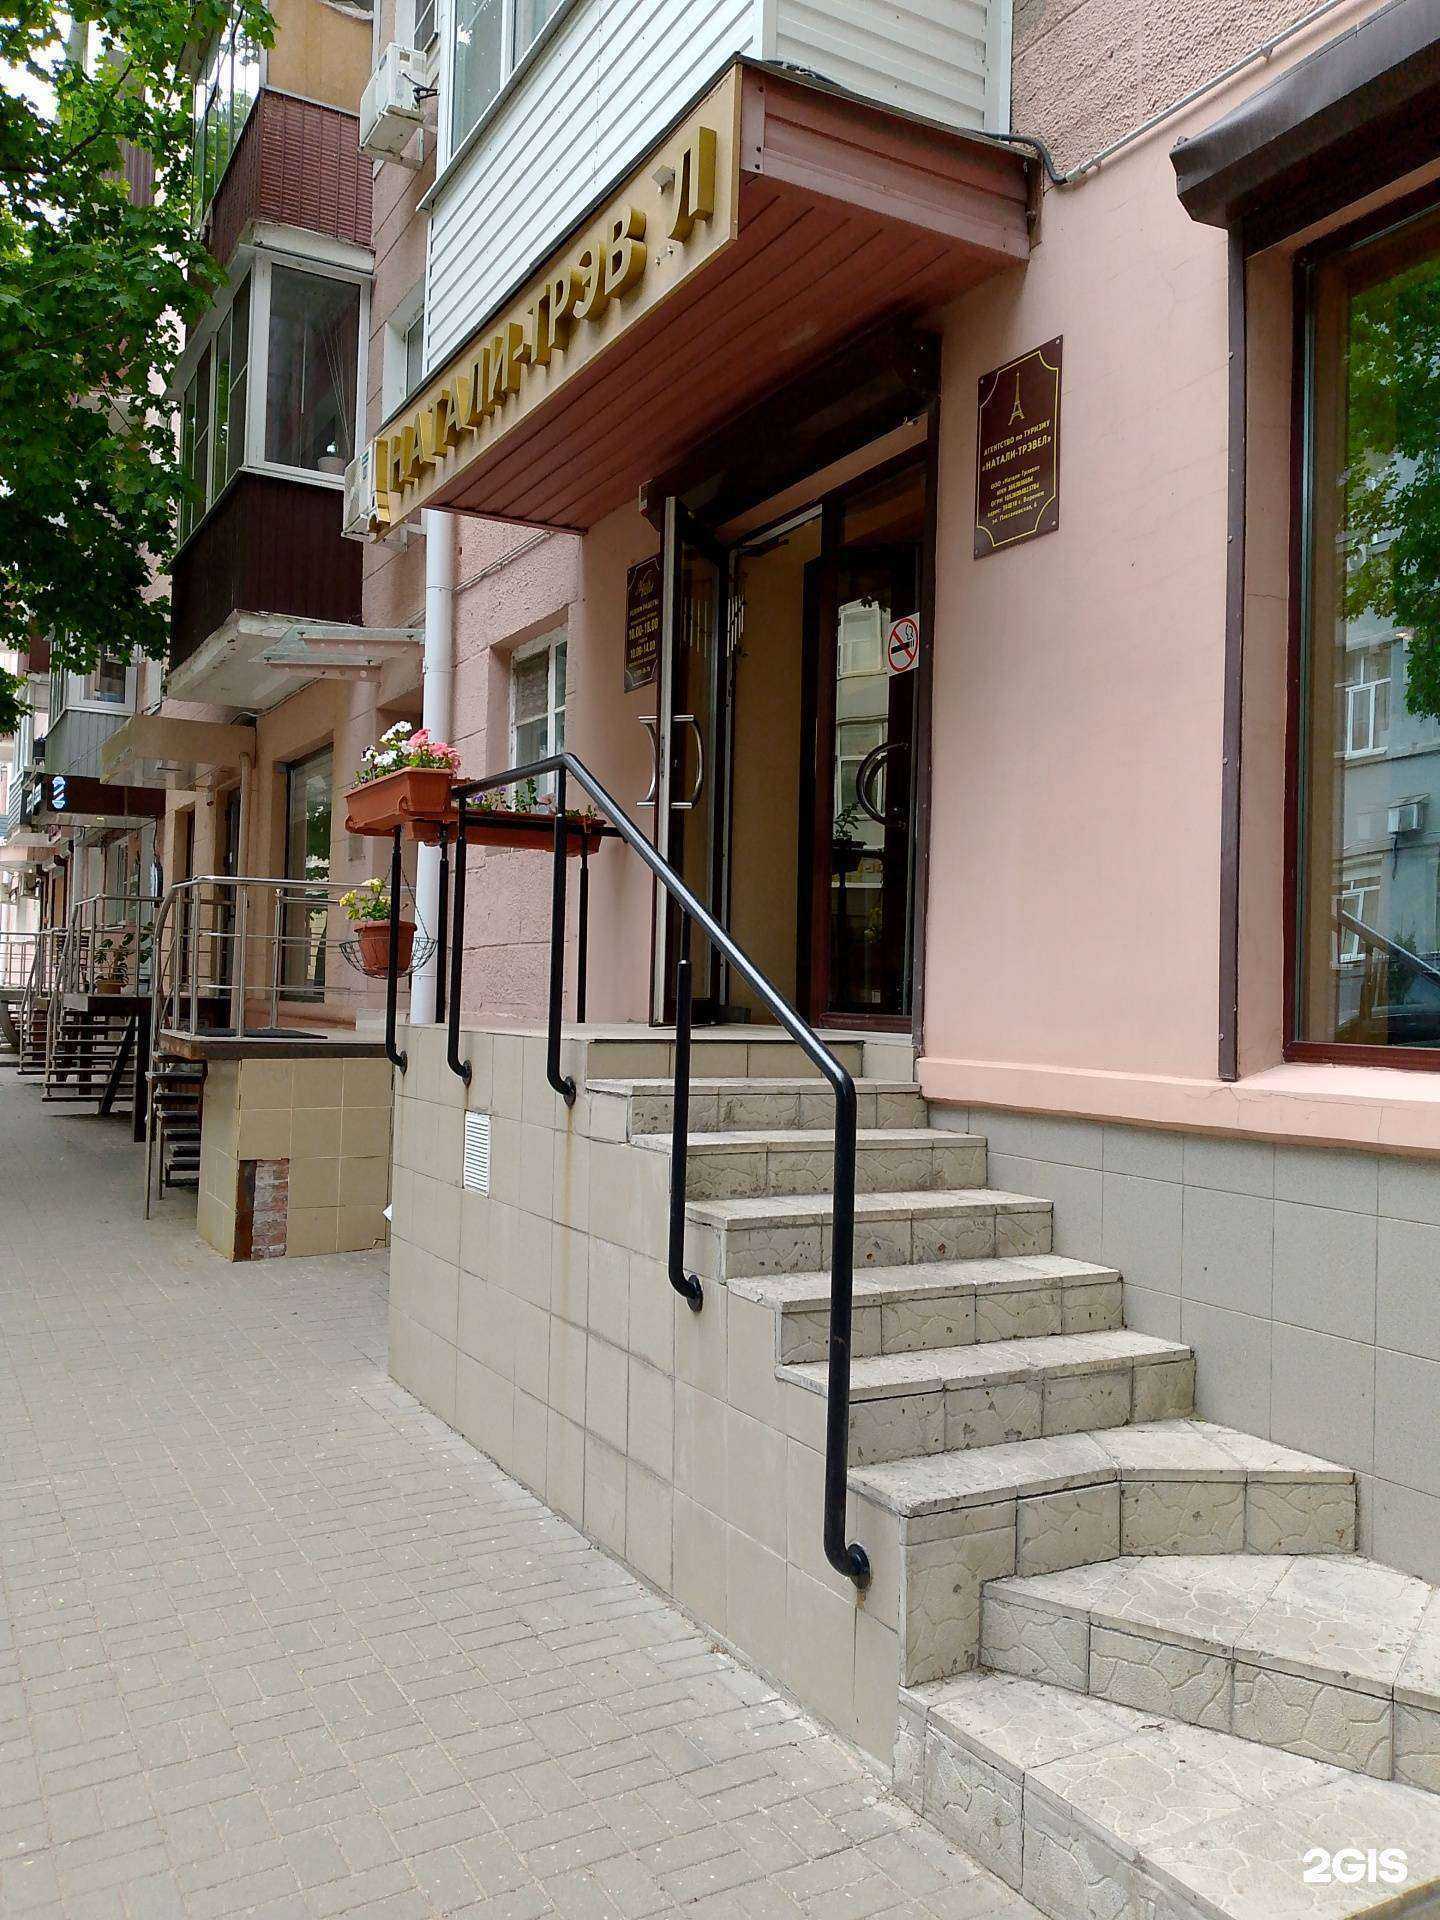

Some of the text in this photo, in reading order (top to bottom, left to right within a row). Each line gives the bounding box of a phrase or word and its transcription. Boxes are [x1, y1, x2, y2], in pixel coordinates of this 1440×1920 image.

[981, 435, 1052, 471] «НАТАЛИ-ТРЭВЕЛ»
[983, 419, 1051, 457] АГЕНТСТВО по ТУРИЗМУ
